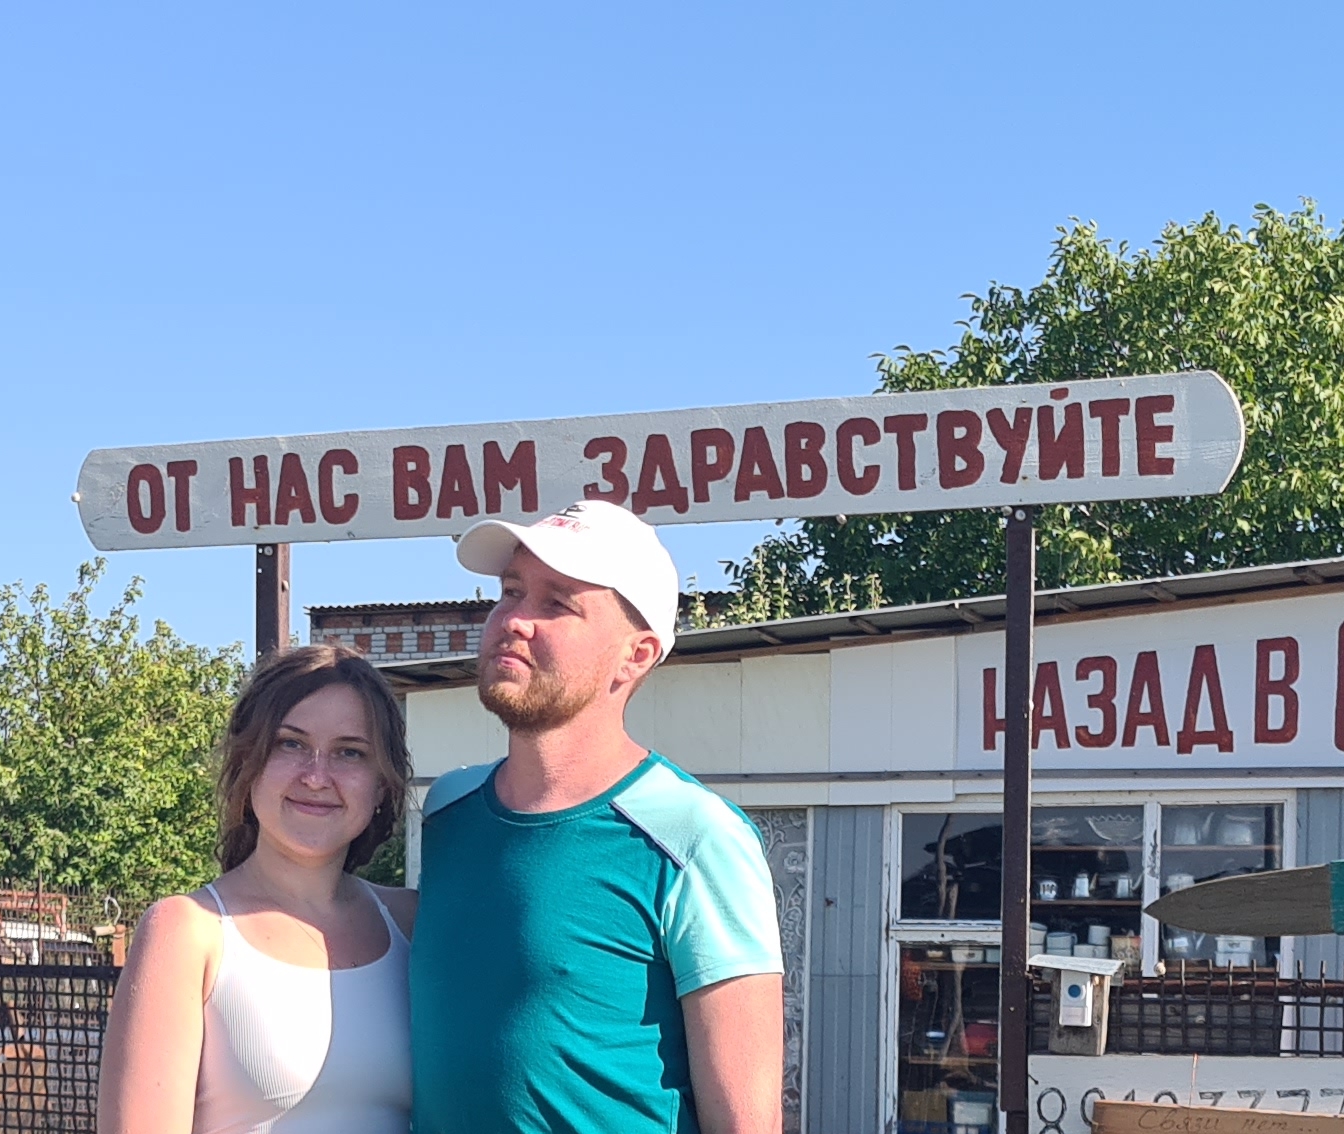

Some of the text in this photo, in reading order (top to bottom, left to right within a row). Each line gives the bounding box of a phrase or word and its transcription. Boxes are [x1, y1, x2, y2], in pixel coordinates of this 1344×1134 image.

[126, 386, 1175, 534] ОТ НАС ВАМ ЗДРАВСТВУЙТЕ
[1254, 635, 1300, 745] В
